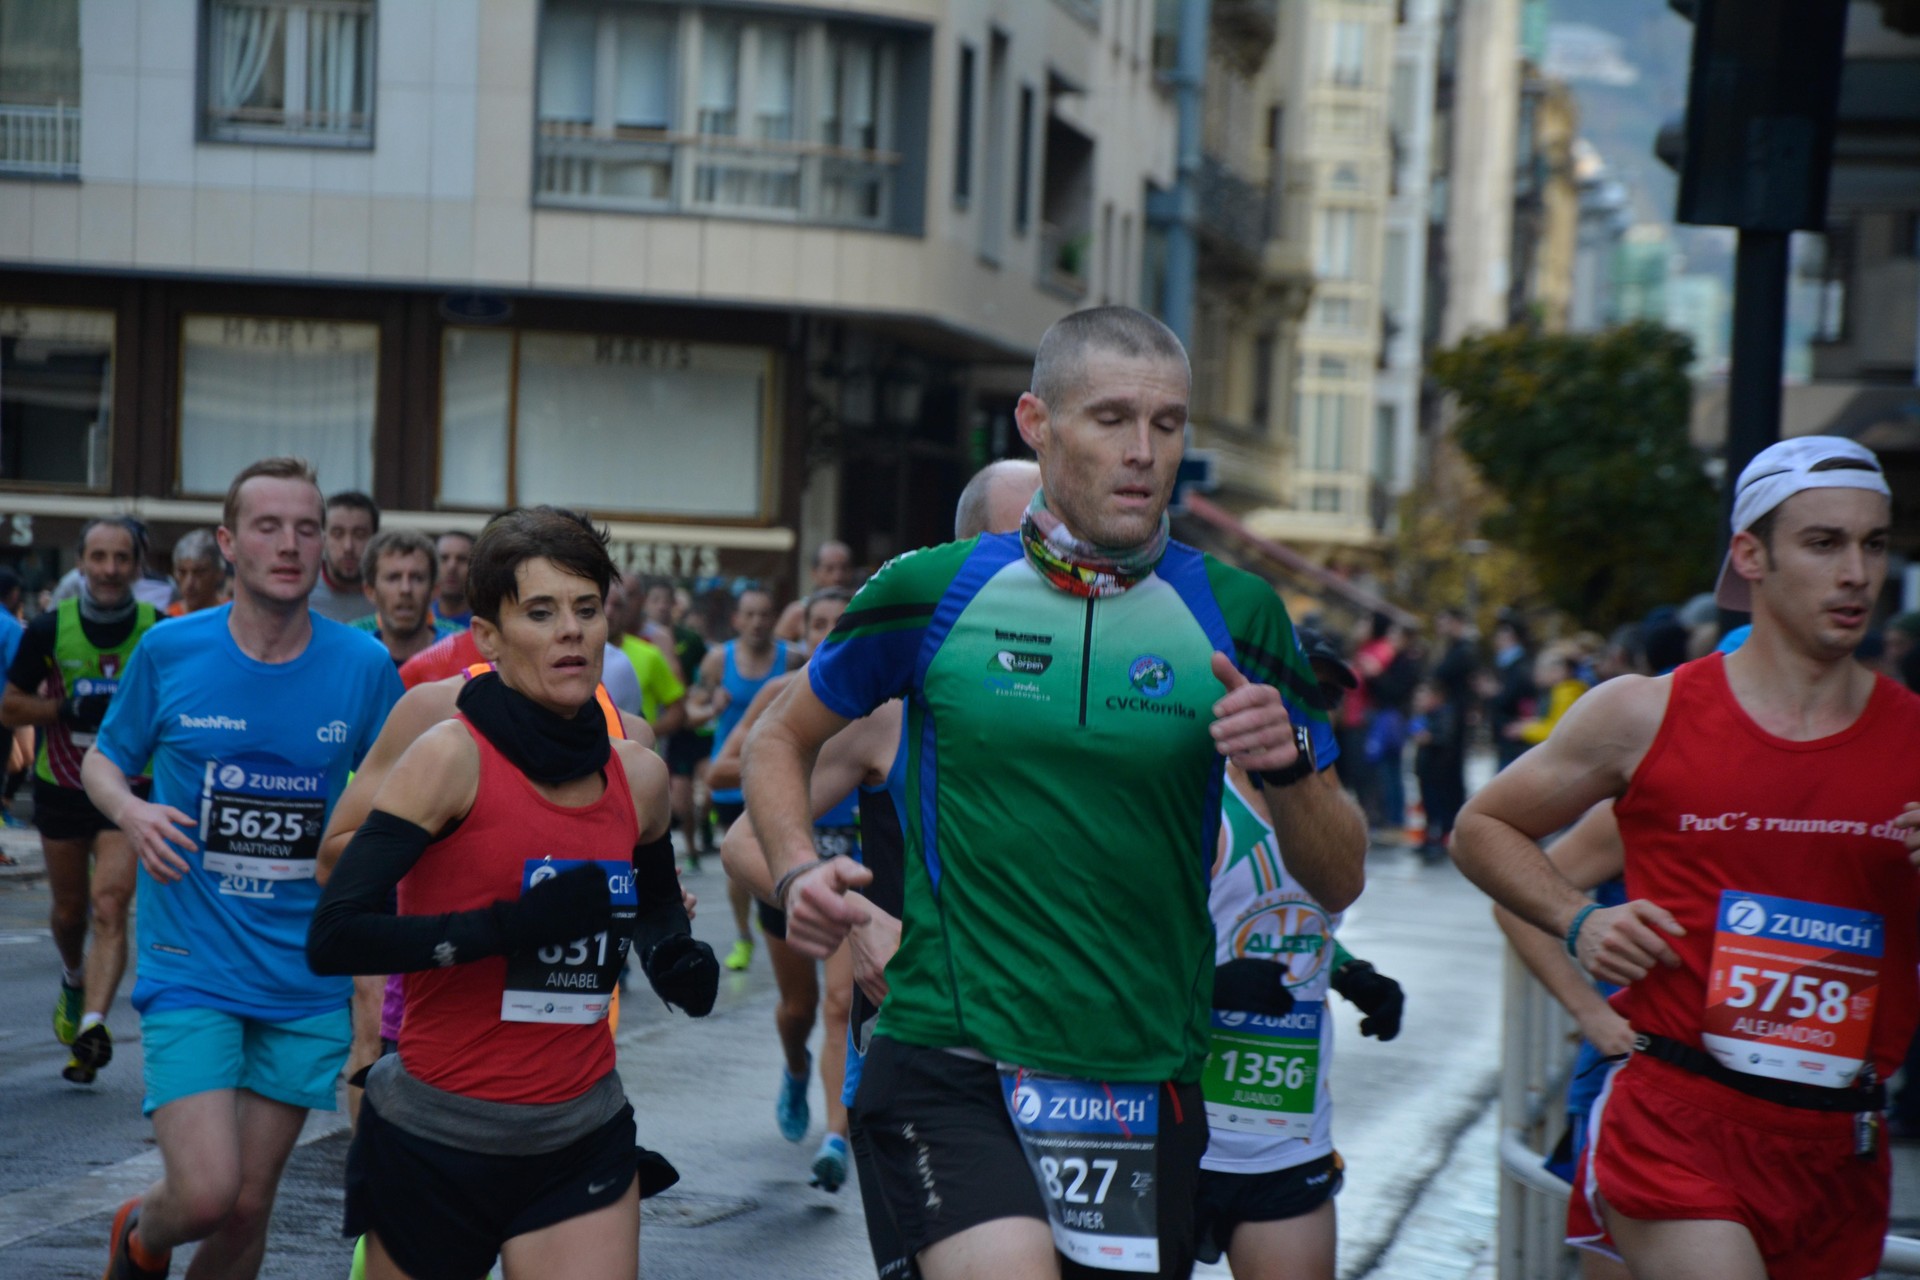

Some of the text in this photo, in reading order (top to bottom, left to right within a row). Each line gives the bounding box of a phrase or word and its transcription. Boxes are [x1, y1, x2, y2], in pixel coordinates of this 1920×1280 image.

[1105, 695, 1197, 720] CVCKorrika
[178, 713, 248, 732] TeachFirst
[316, 720, 348, 744] citi
[248, 773, 318, 792] ZURICH
[218, 807, 304, 842] 5625
[1764, 816, 1868, 836] runners
[1869, 818, 1913, 842] clu
[229, 841, 293, 857] MATTHEW
[1769, 913, 1873, 949] ZURICH
[545, 971, 600, 989] ANABEL
[1725, 964, 1850, 1024] 5758
[1731, 1016, 1837, 1048] ALEJANDRO
[1221, 1048, 1305, 1091] 1356
[1048, 1096, 1146, 1122] ZURICH
[1038, 1155, 1119, 1205] 827
